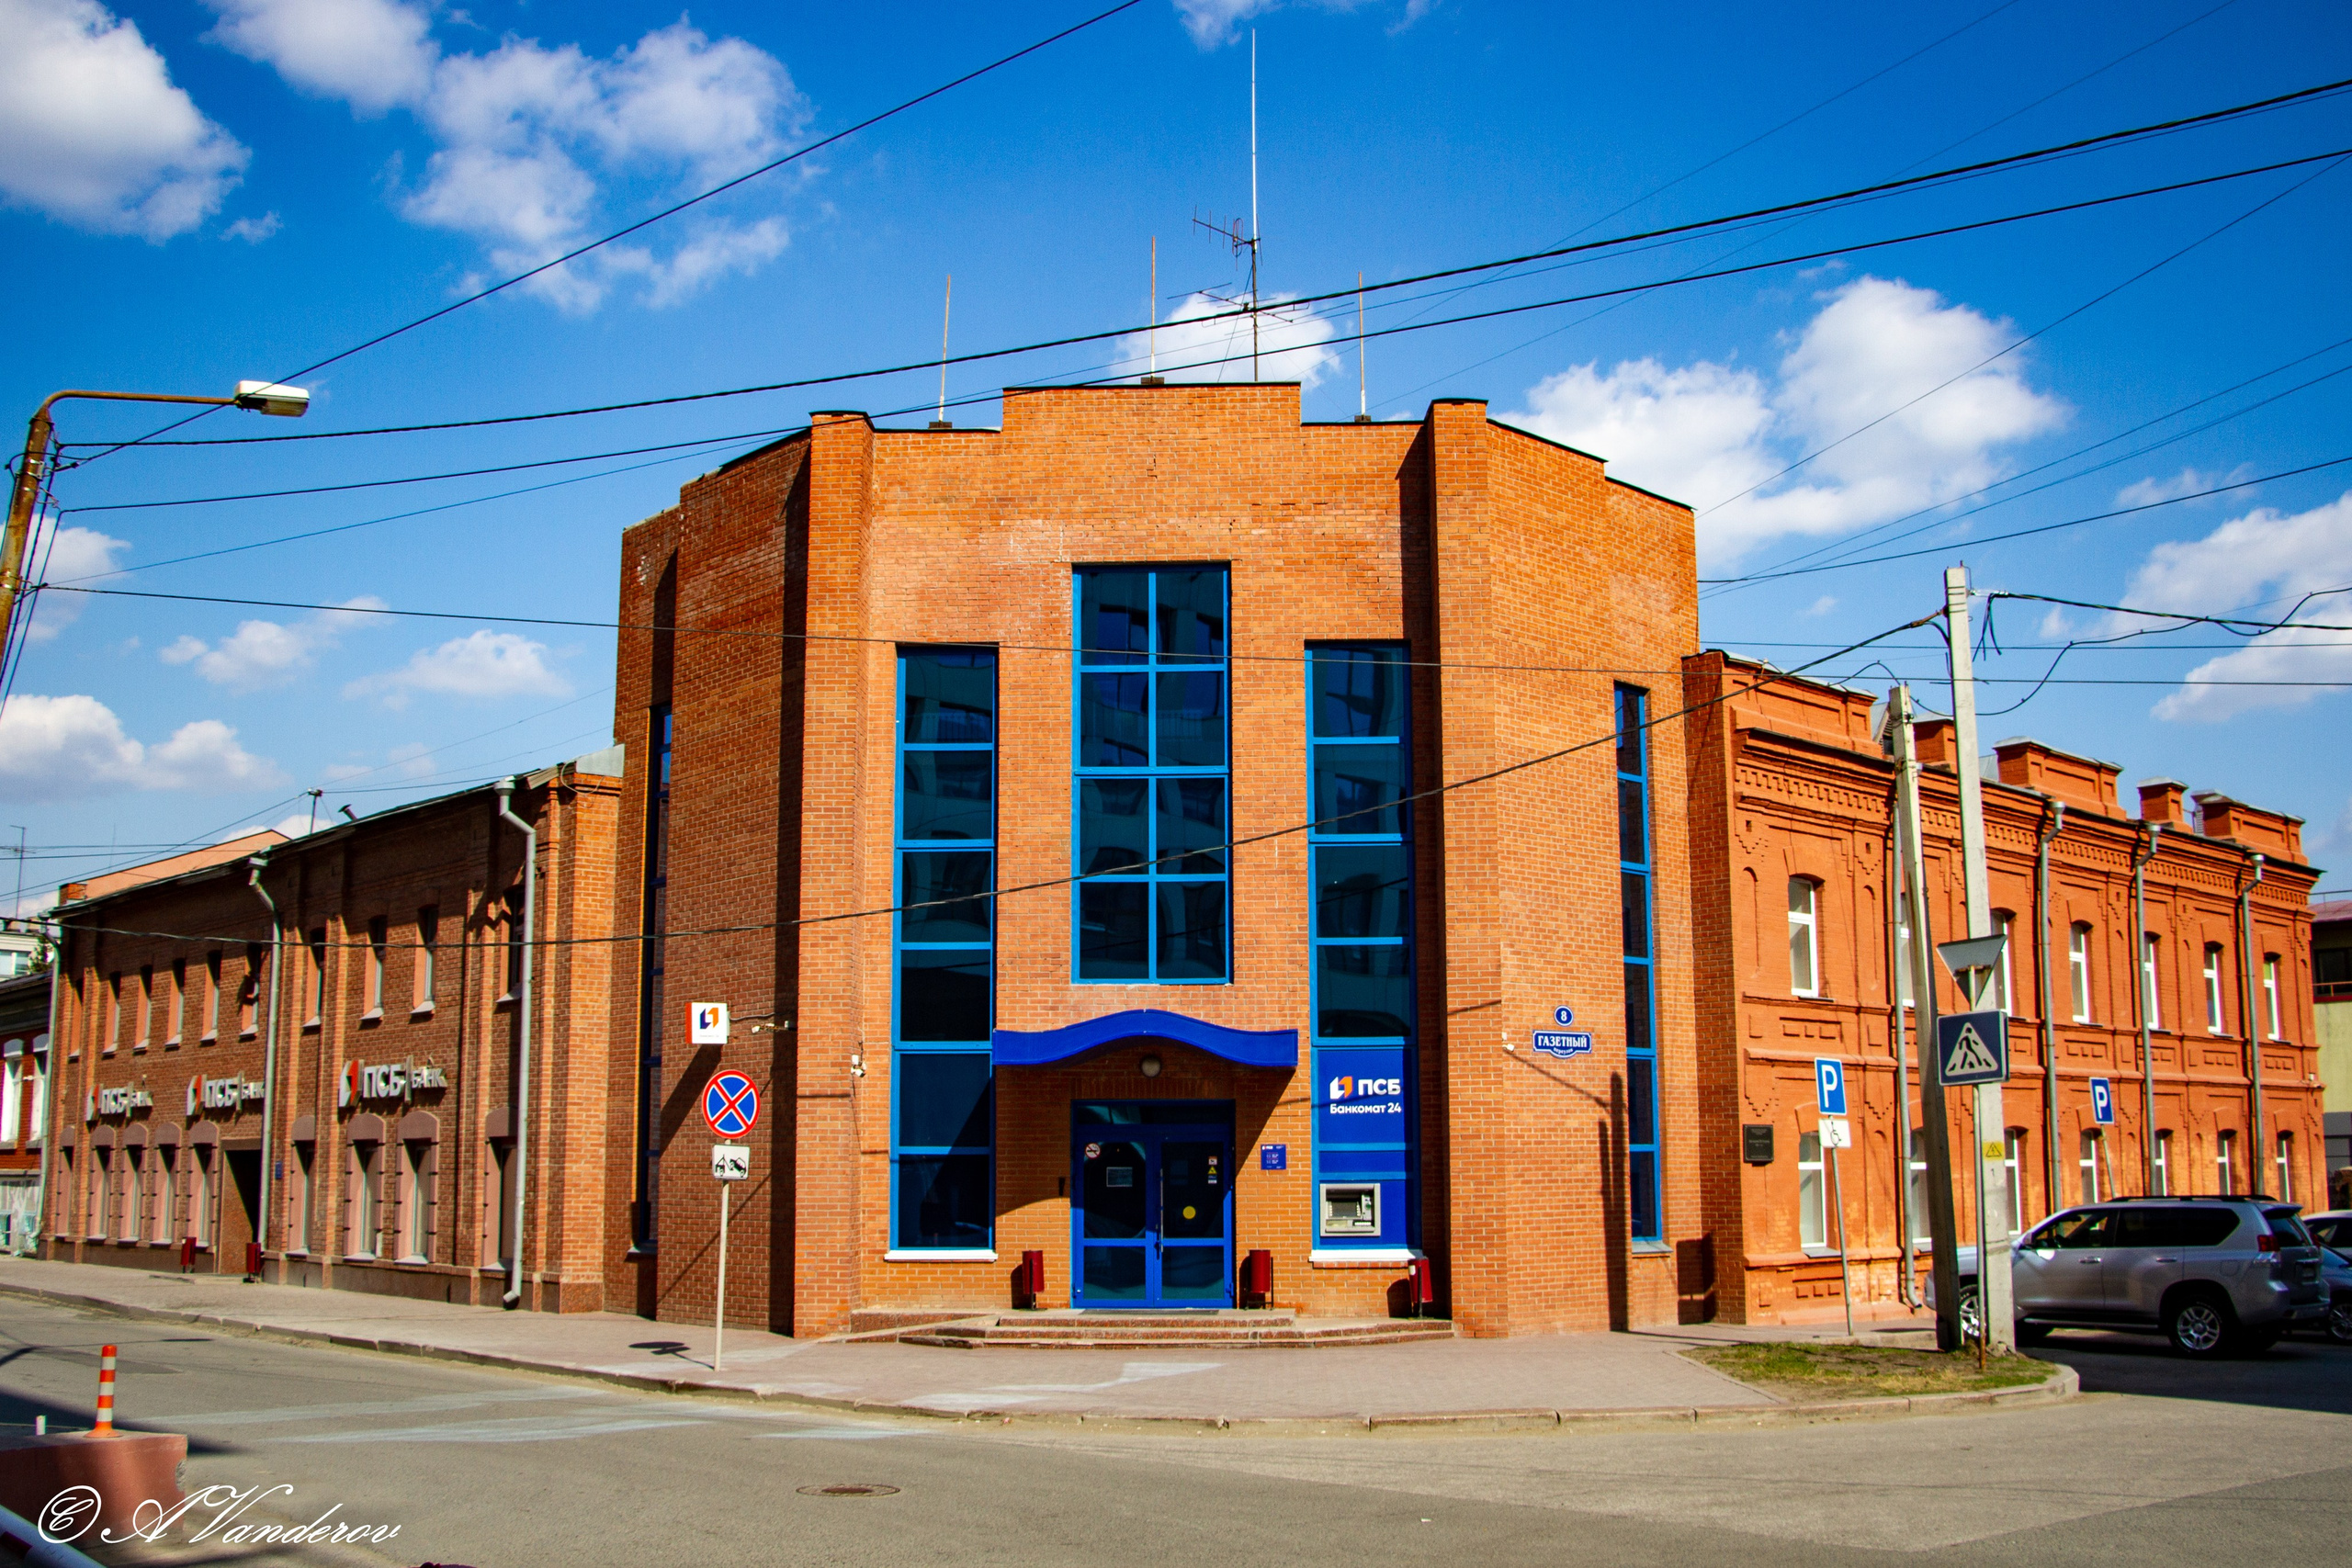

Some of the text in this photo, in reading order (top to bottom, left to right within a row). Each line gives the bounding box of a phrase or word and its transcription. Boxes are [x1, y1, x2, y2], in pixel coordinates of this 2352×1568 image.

[1560, 1010, 1567, 1021] 8
[1537, 1035, 1588, 1048] ГАЗЕТНЫЙ
[204, 1078, 237, 1108] ПСБ
[363, 1064, 447, 1098] ПСБ БАНК
[1358, 1078, 1401, 1096] ПСБ
[1821, 1064, 1838, 1109] P
[100, 1087, 128, 1114] ПСБ
[1329, 1102, 1402, 1114] Банкомат 24
[2095, 1086, 2108, 1119] P
